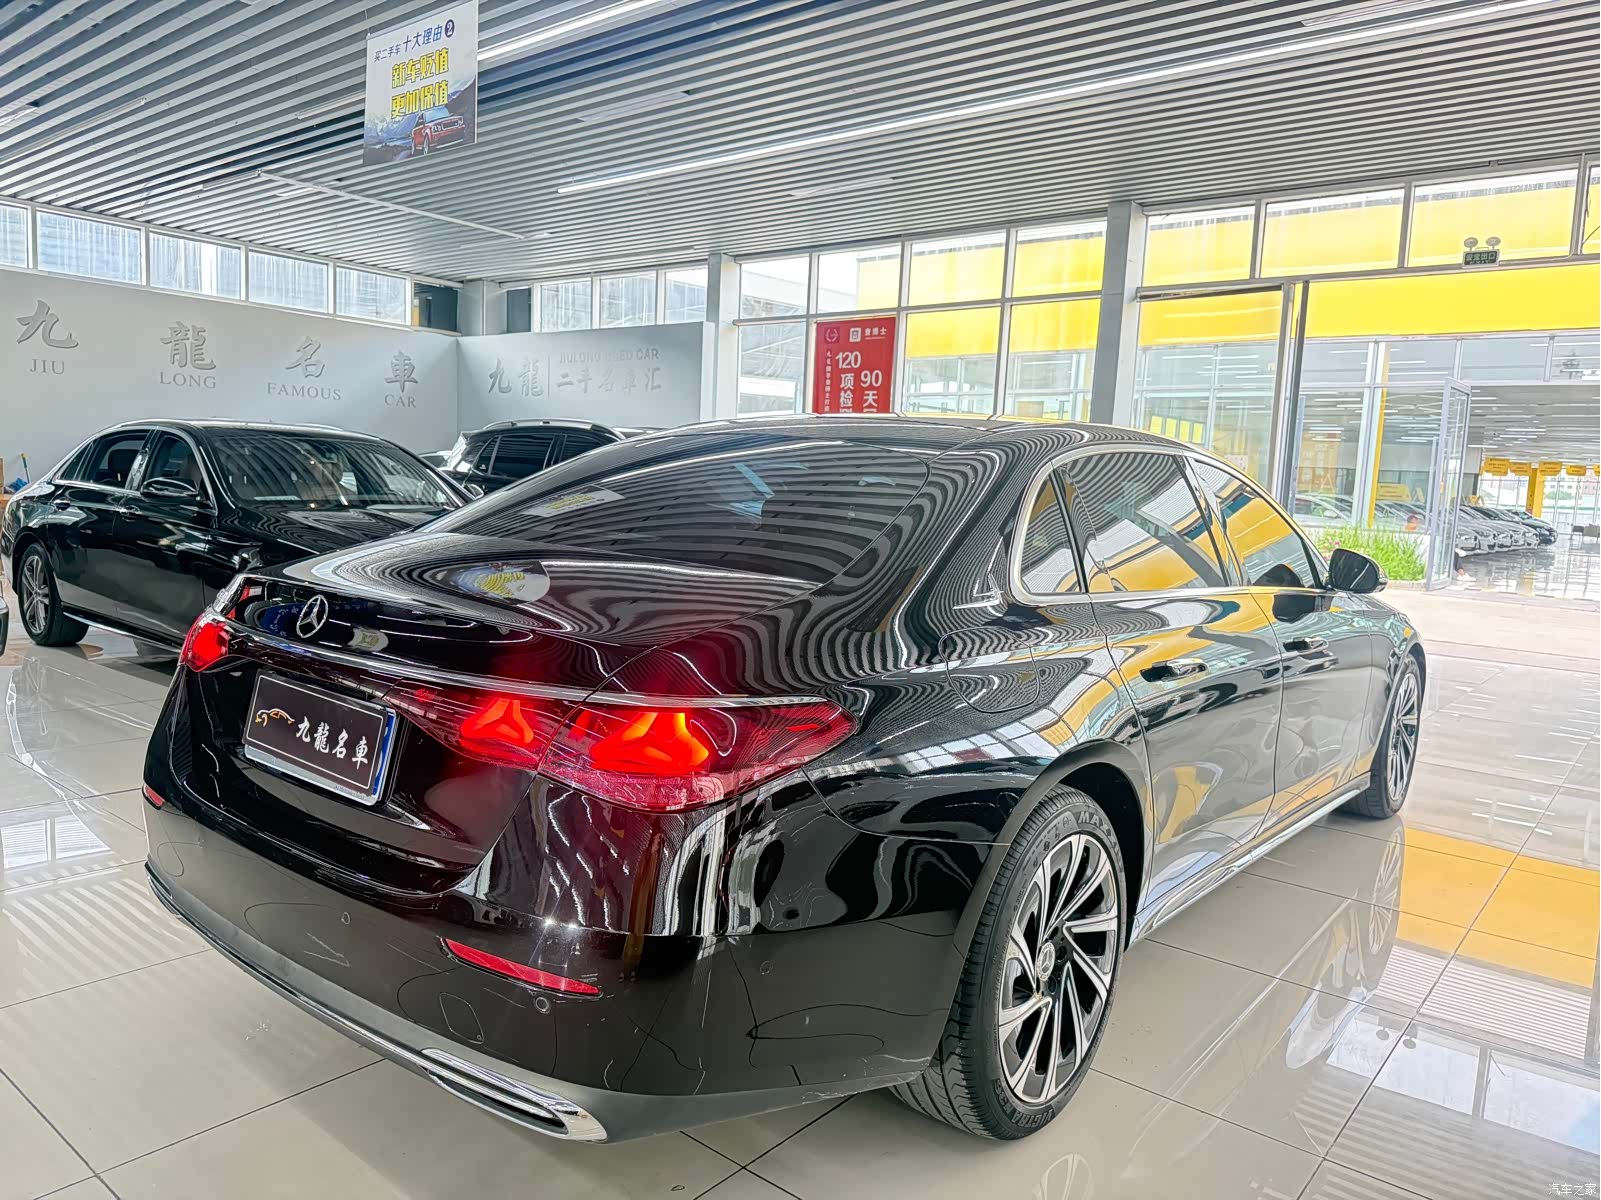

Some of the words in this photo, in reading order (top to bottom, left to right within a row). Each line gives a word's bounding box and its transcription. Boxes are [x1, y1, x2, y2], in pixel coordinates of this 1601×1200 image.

[374, 24, 443, 62] 买二手车十大理由
[391, 47, 449, 89] 新车贬值
[391, 80, 449, 119] 更加保值
[636, 347, 660, 361] CAR
[835, 351, 861, 369] 120
[29, 358, 65, 375] JIU
[159, 371, 216, 389] LONG
[266, 382, 342, 401] FAMOUS
[384, 394, 417, 408] CAR
[860, 370, 882, 387] 90
[296, 715, 369, 770] 九龍名車
